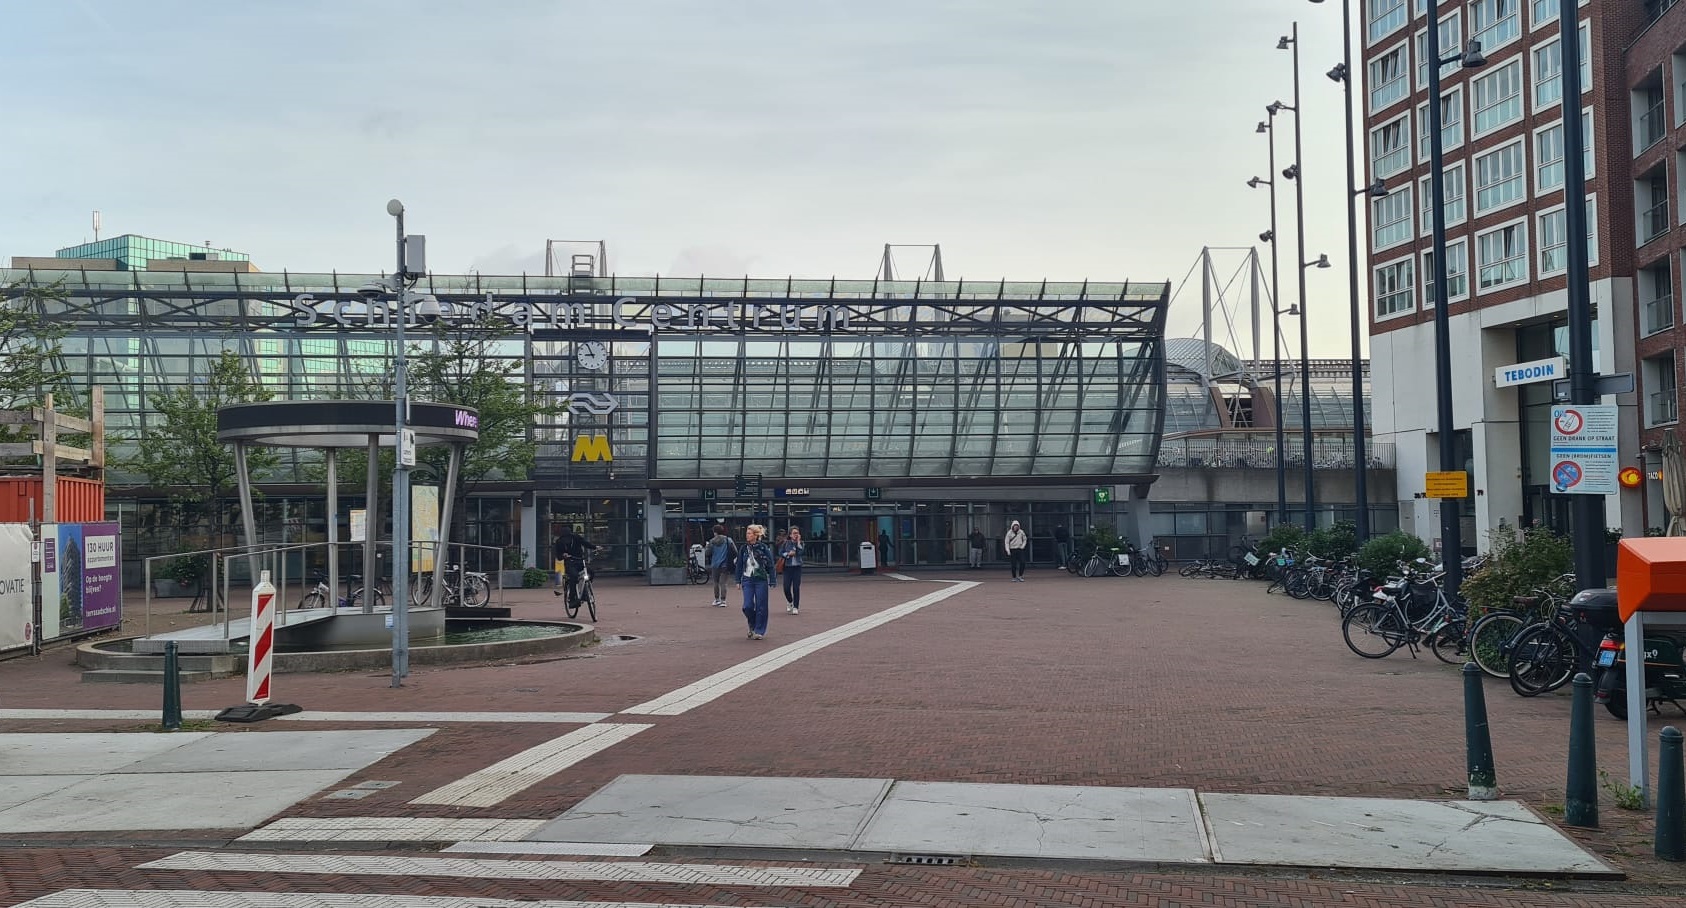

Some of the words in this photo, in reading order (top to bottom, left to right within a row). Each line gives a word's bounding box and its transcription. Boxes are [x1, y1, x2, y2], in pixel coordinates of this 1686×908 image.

[295, 292, 586, 326] Schiedam
[613, 297, 850, 329] Centrum
[1504, 364, 1554, 382] TEBODIN
[87, 542, 96, 553] 130
[98, 541, 114, 553] HUUR
[86, 575, 92, 584] Op
